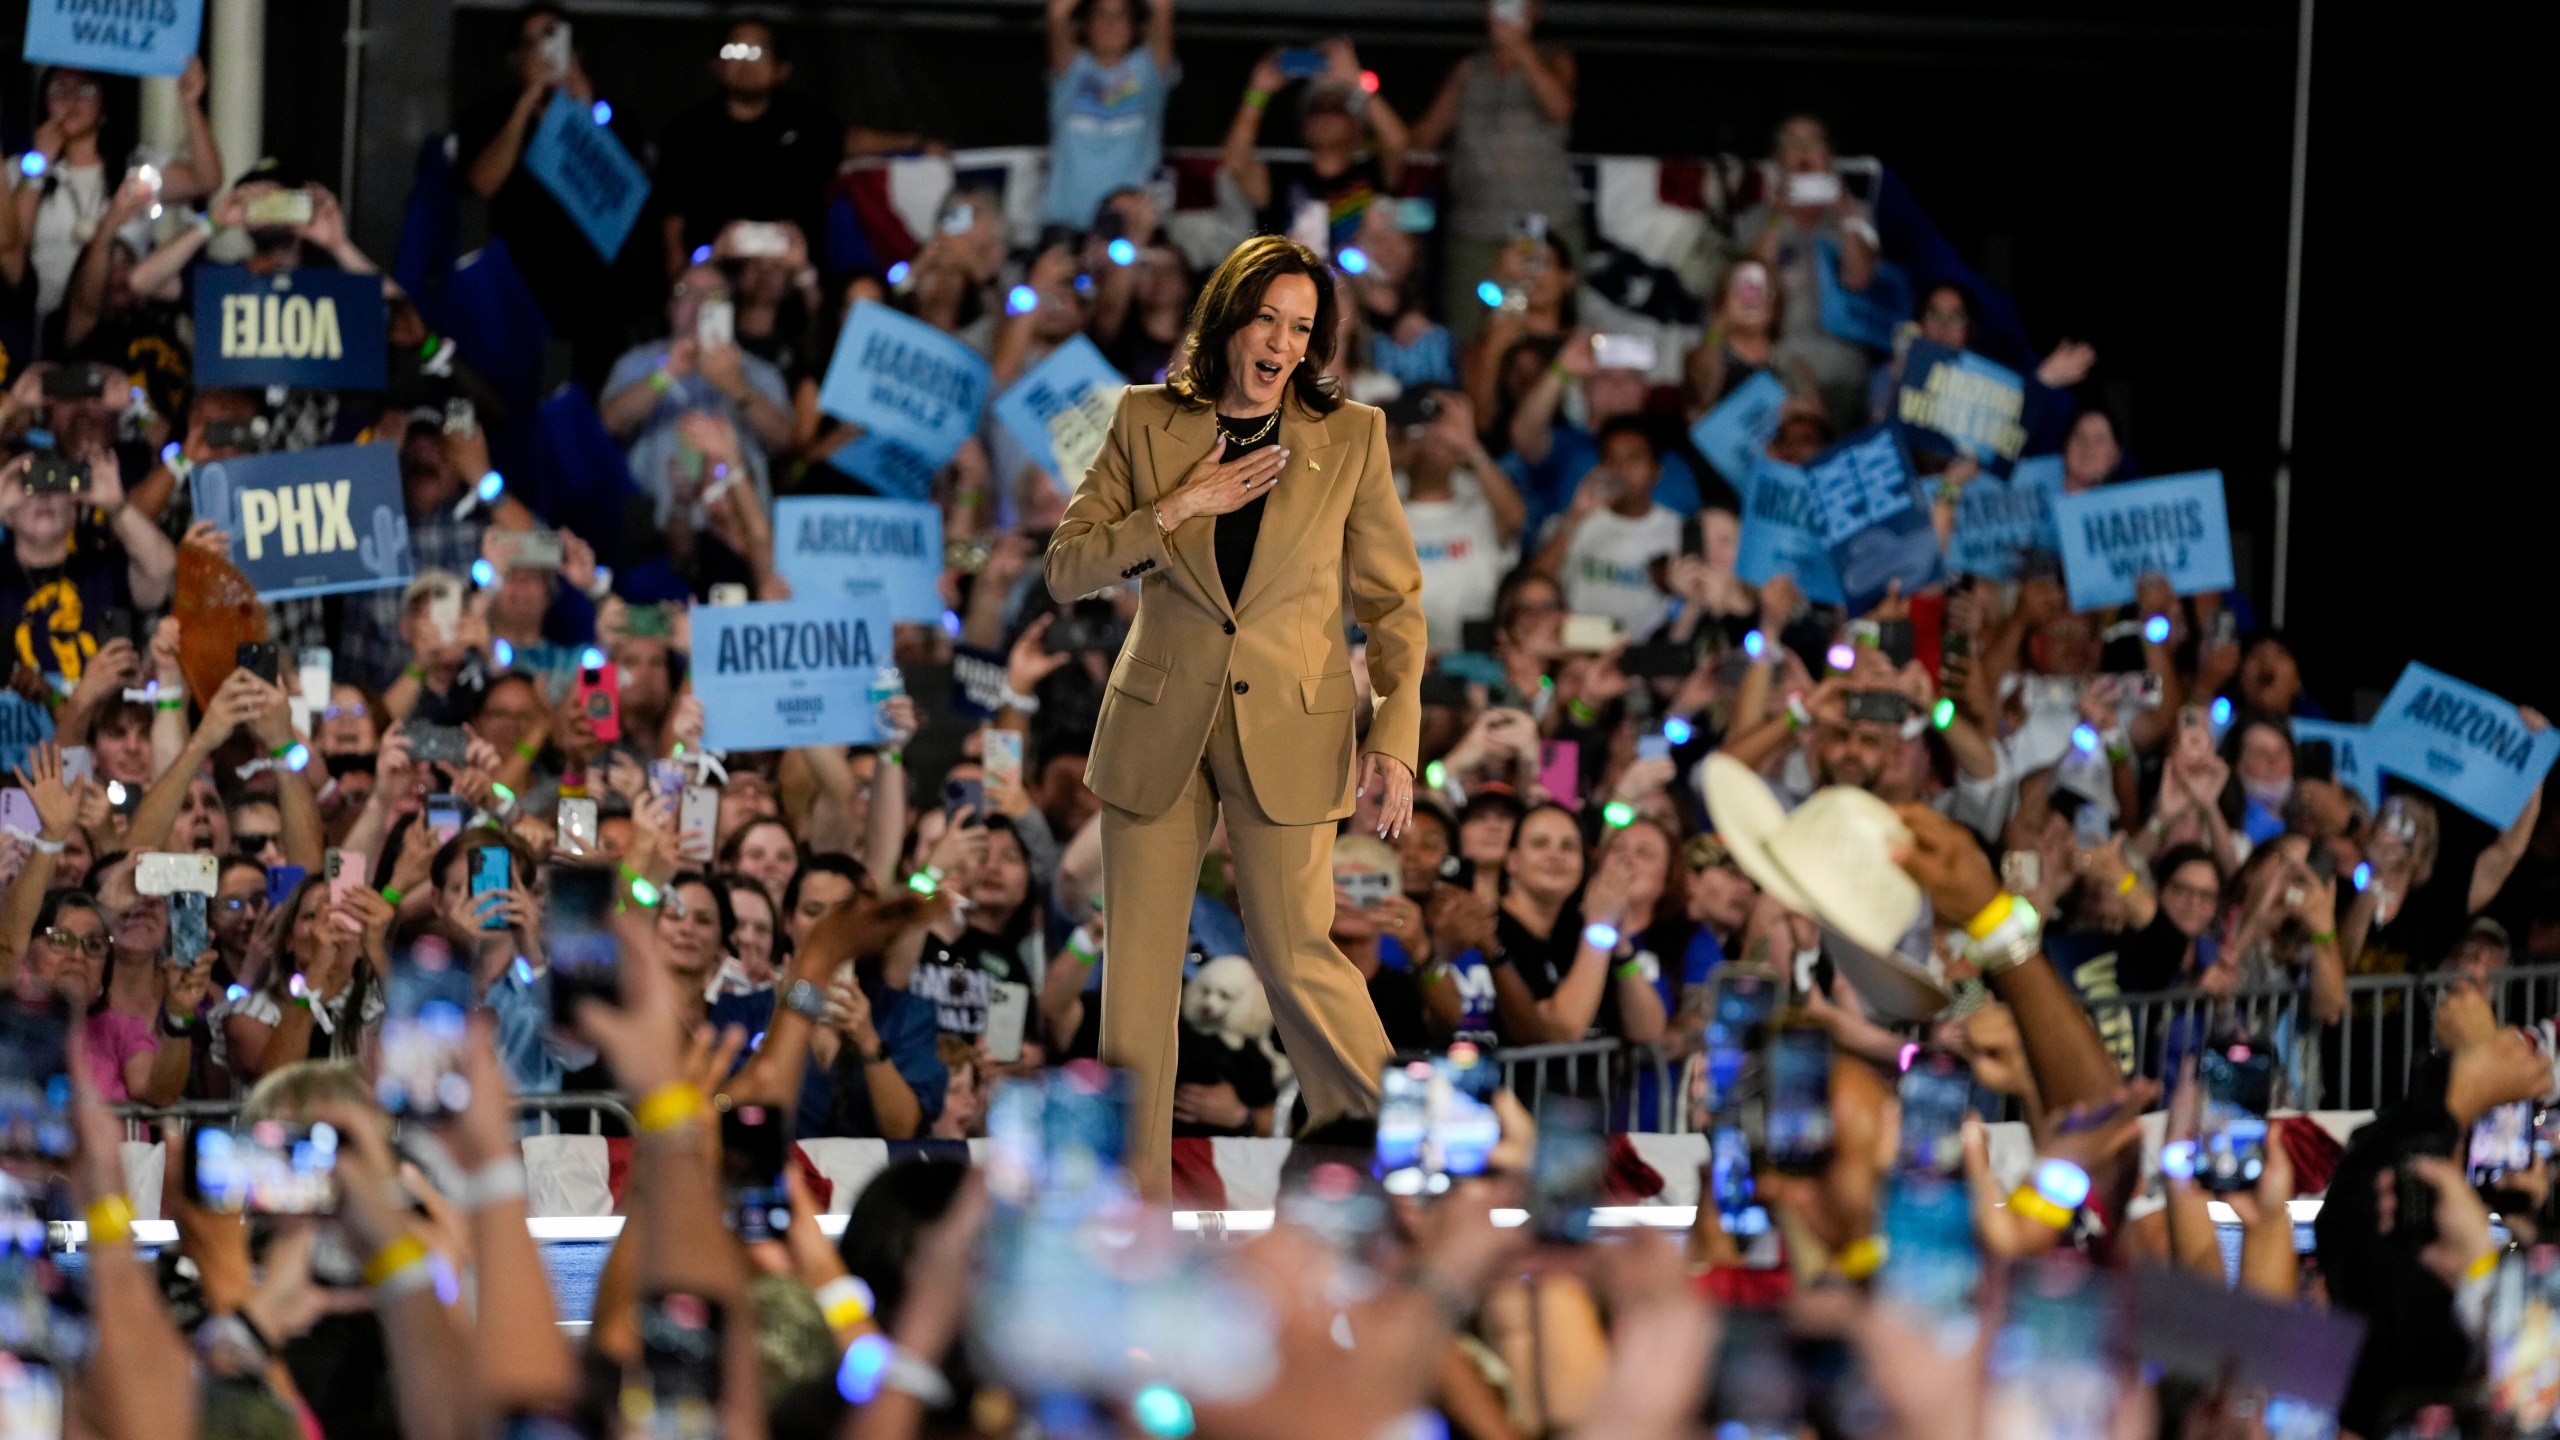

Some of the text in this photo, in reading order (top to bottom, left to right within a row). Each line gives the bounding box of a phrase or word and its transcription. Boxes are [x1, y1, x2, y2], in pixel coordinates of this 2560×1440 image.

[71, 19, 156, 51] WALZ
[221, 294, 343, 360] VOTE!
[241, 479, 358, 561] PHX
[2083, 498, 2206, 558] HARRIS
[717, 617, 876, 675] ARIZONA
[2402, 683, 2535, 775] ARIZONA
